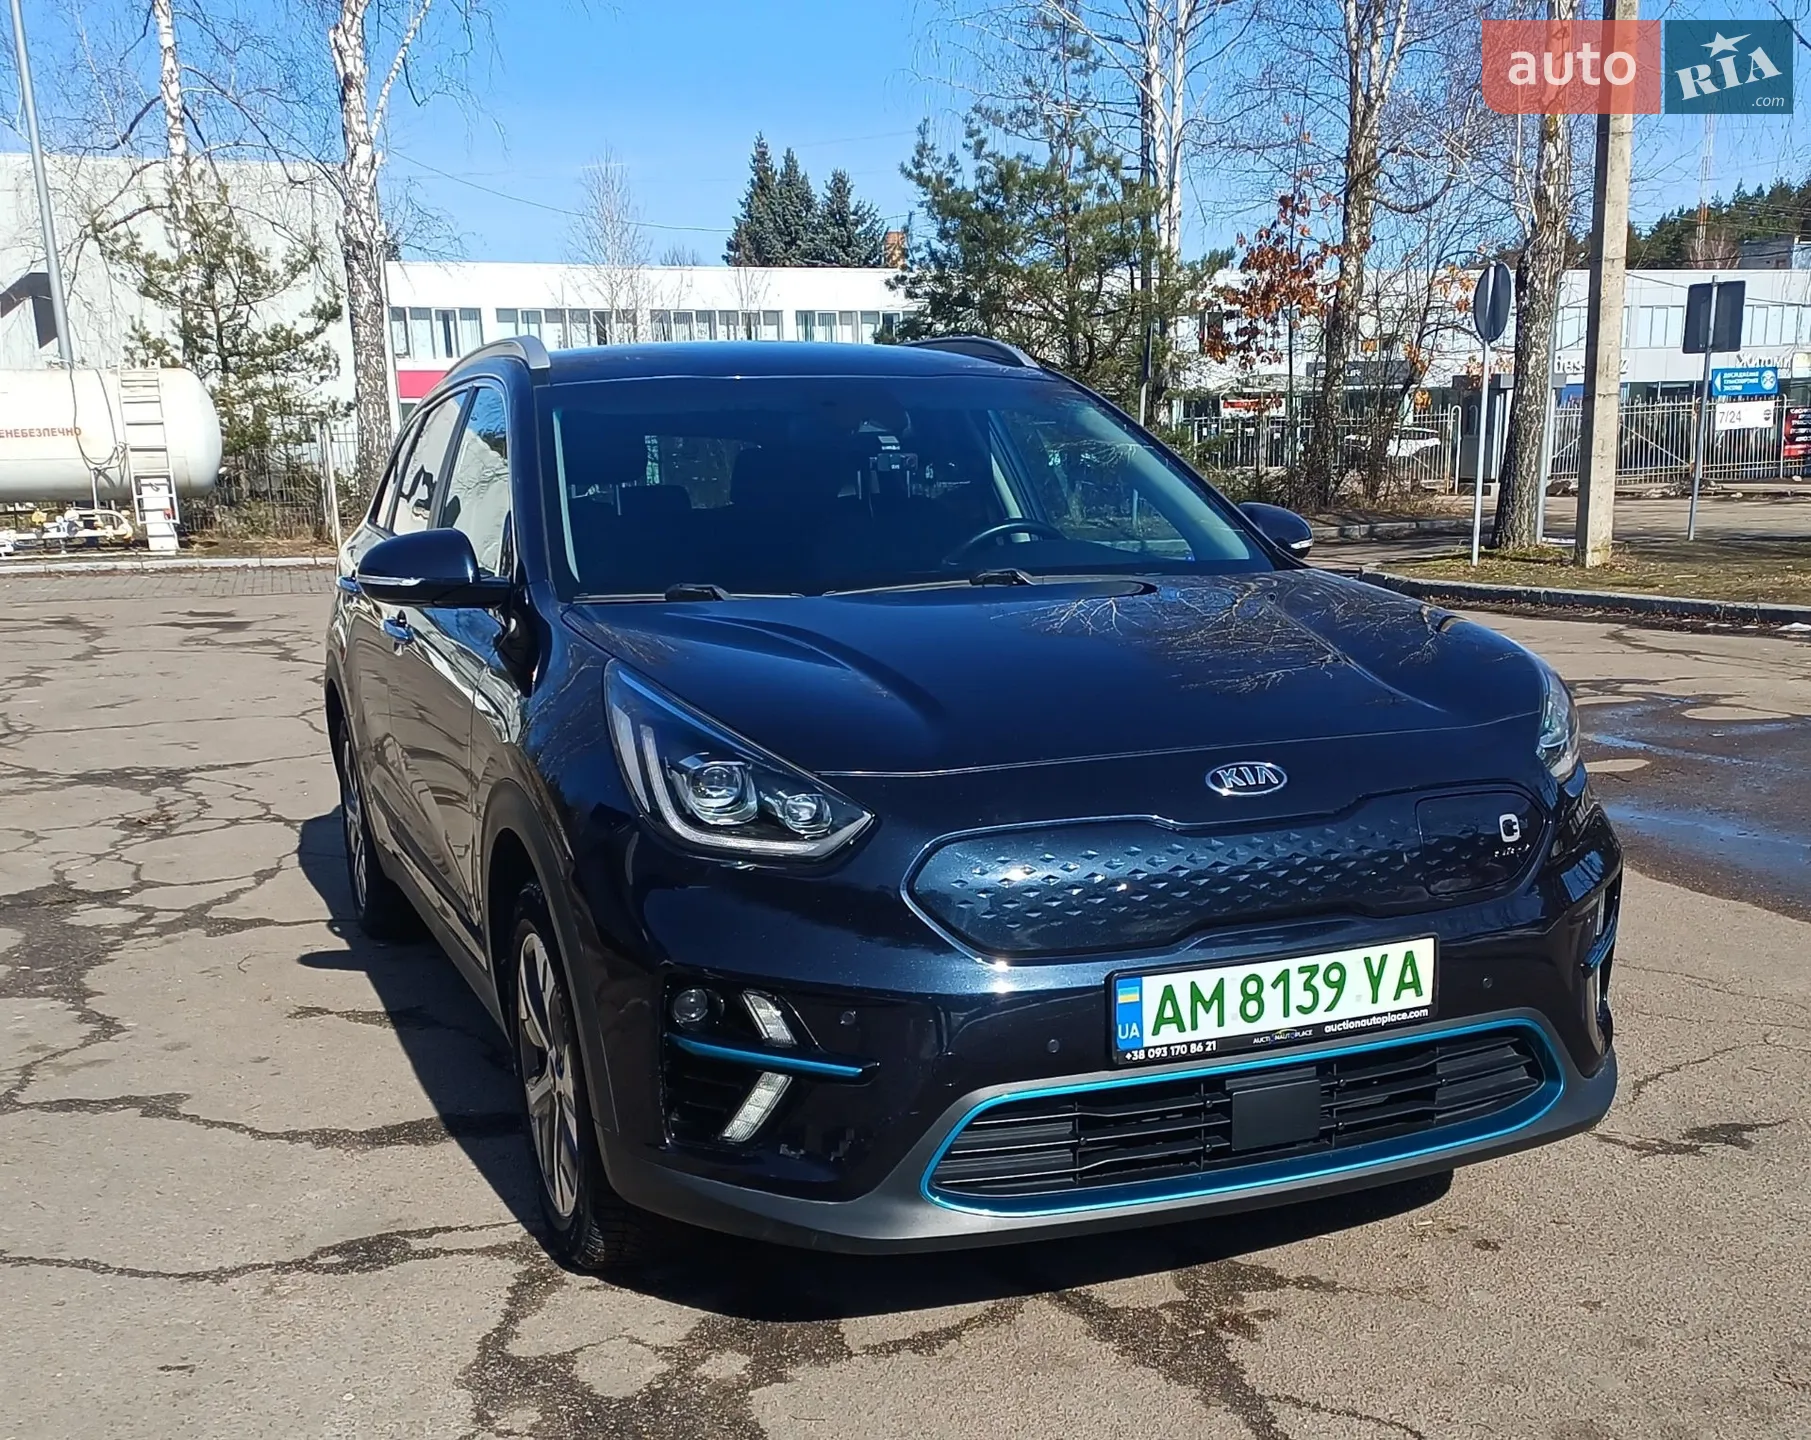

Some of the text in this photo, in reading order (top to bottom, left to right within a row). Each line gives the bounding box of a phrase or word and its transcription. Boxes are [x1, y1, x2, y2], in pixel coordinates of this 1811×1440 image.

[1719, 410, 1742, 424] 7/24
[1217, 766, 1279, 788] KIA
[1152, 950, 1424, 1036] AM 8139 YA
[1118, 1023, 1140, 1039] UA
[1324, 1008, 1429, 1034] auctionautoplace.com
[1125, 1040, 1217, 1061] +38 093 170 86 21
